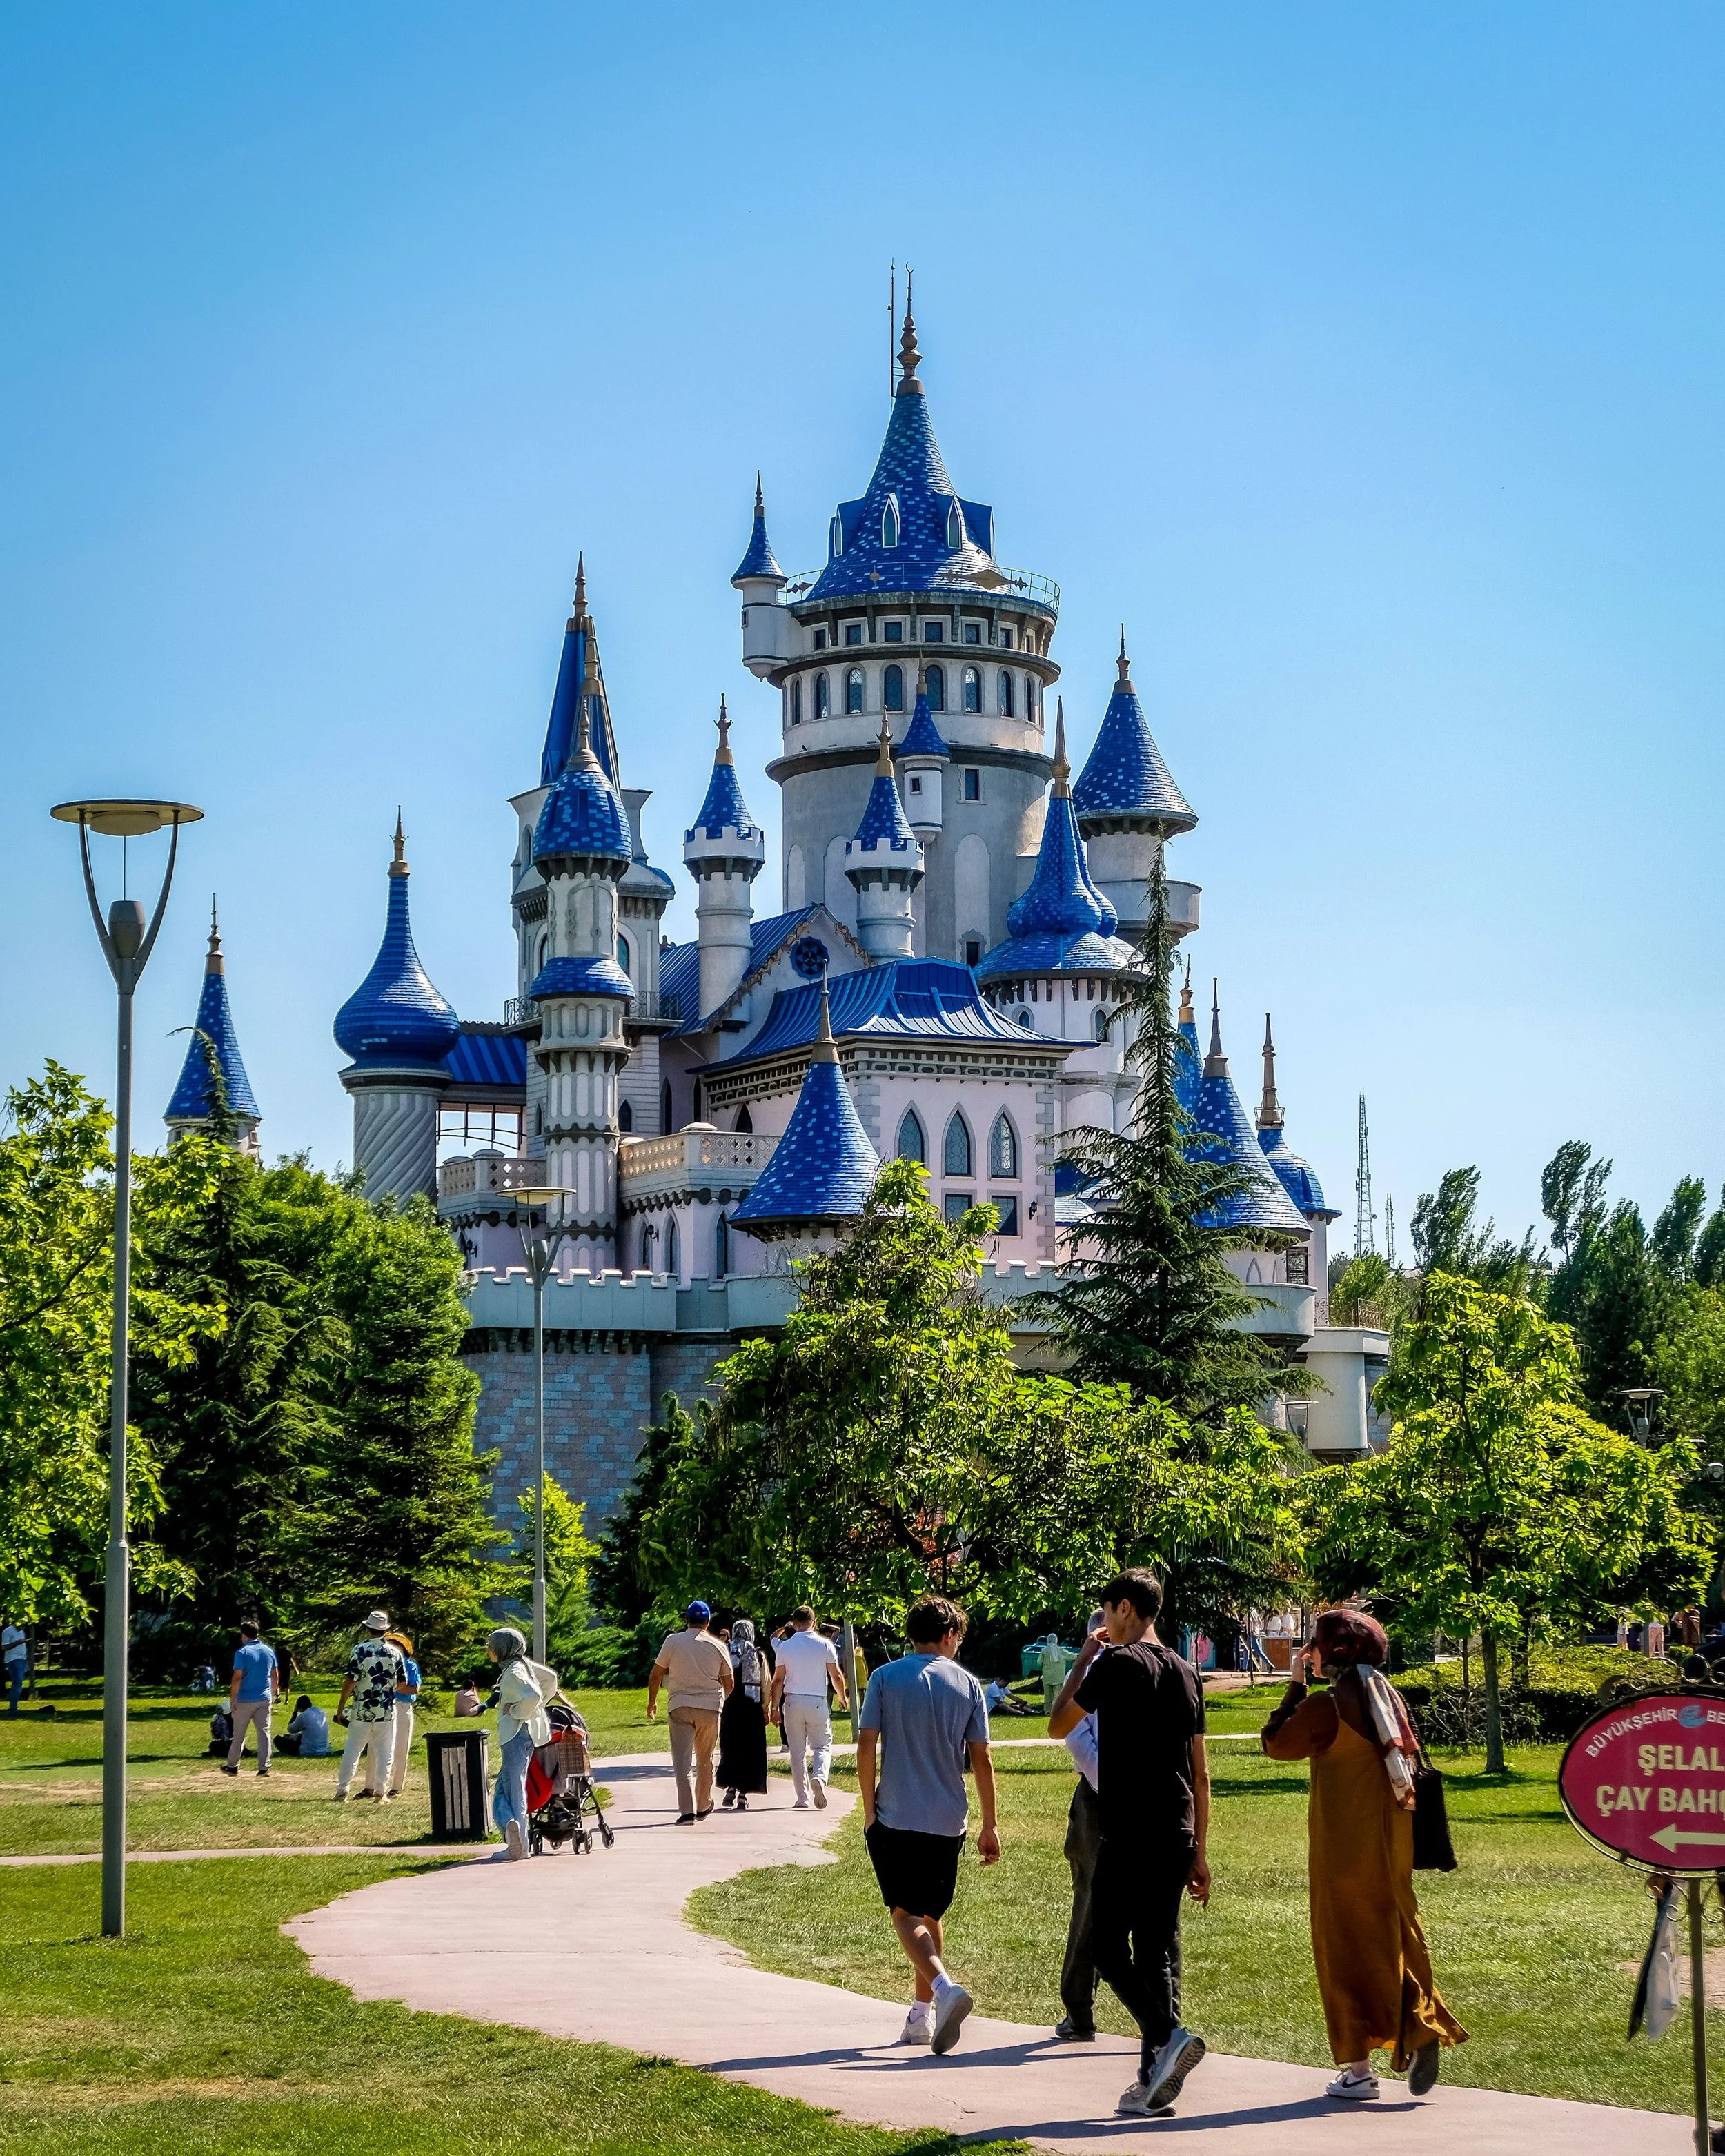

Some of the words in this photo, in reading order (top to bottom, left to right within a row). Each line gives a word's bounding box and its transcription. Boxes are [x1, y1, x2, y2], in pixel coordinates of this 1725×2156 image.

[1585, 1707, 1678, 1758] BÜYÜKŞEHİR
[1637, 1744, 1725, 1776] ŞELAL
[1596, 1785, 1652, 1817] ÇAY
